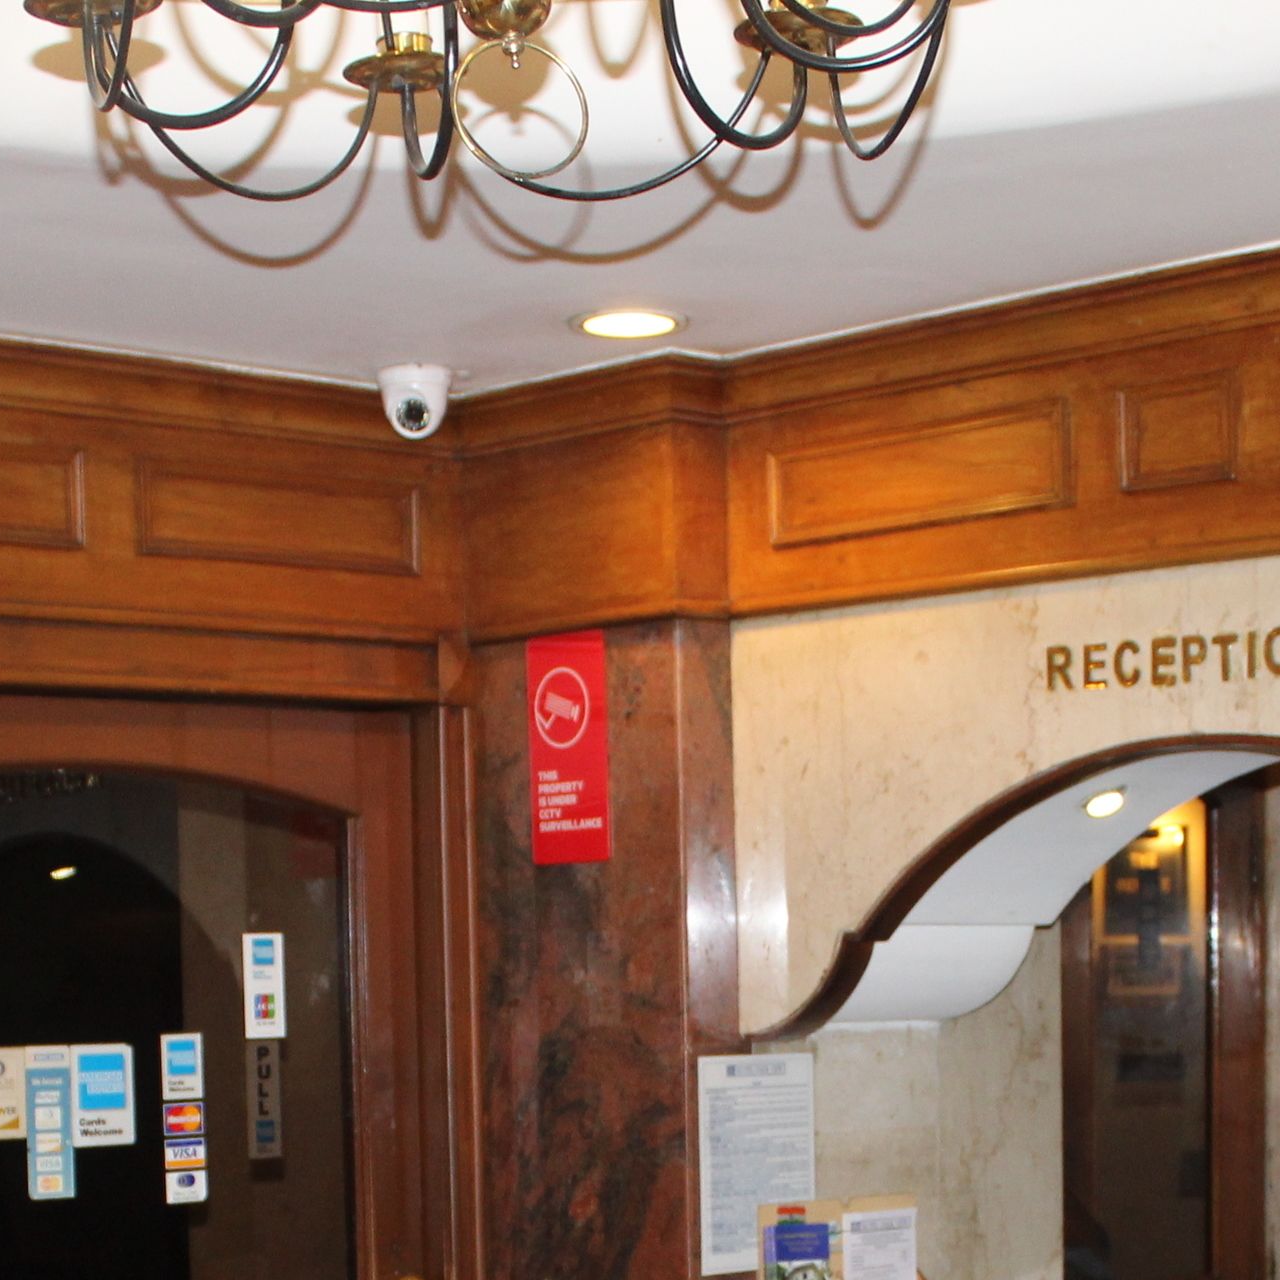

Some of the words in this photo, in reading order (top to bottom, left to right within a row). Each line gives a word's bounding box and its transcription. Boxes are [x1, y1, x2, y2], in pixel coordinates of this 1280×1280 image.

[256, 1045, 272, 1116] PULL
[79, 1118, 107, 1127] Cards
[79, 1127, 124, 1138] Welcome
[172, 1147, 198, 1159] VISA
